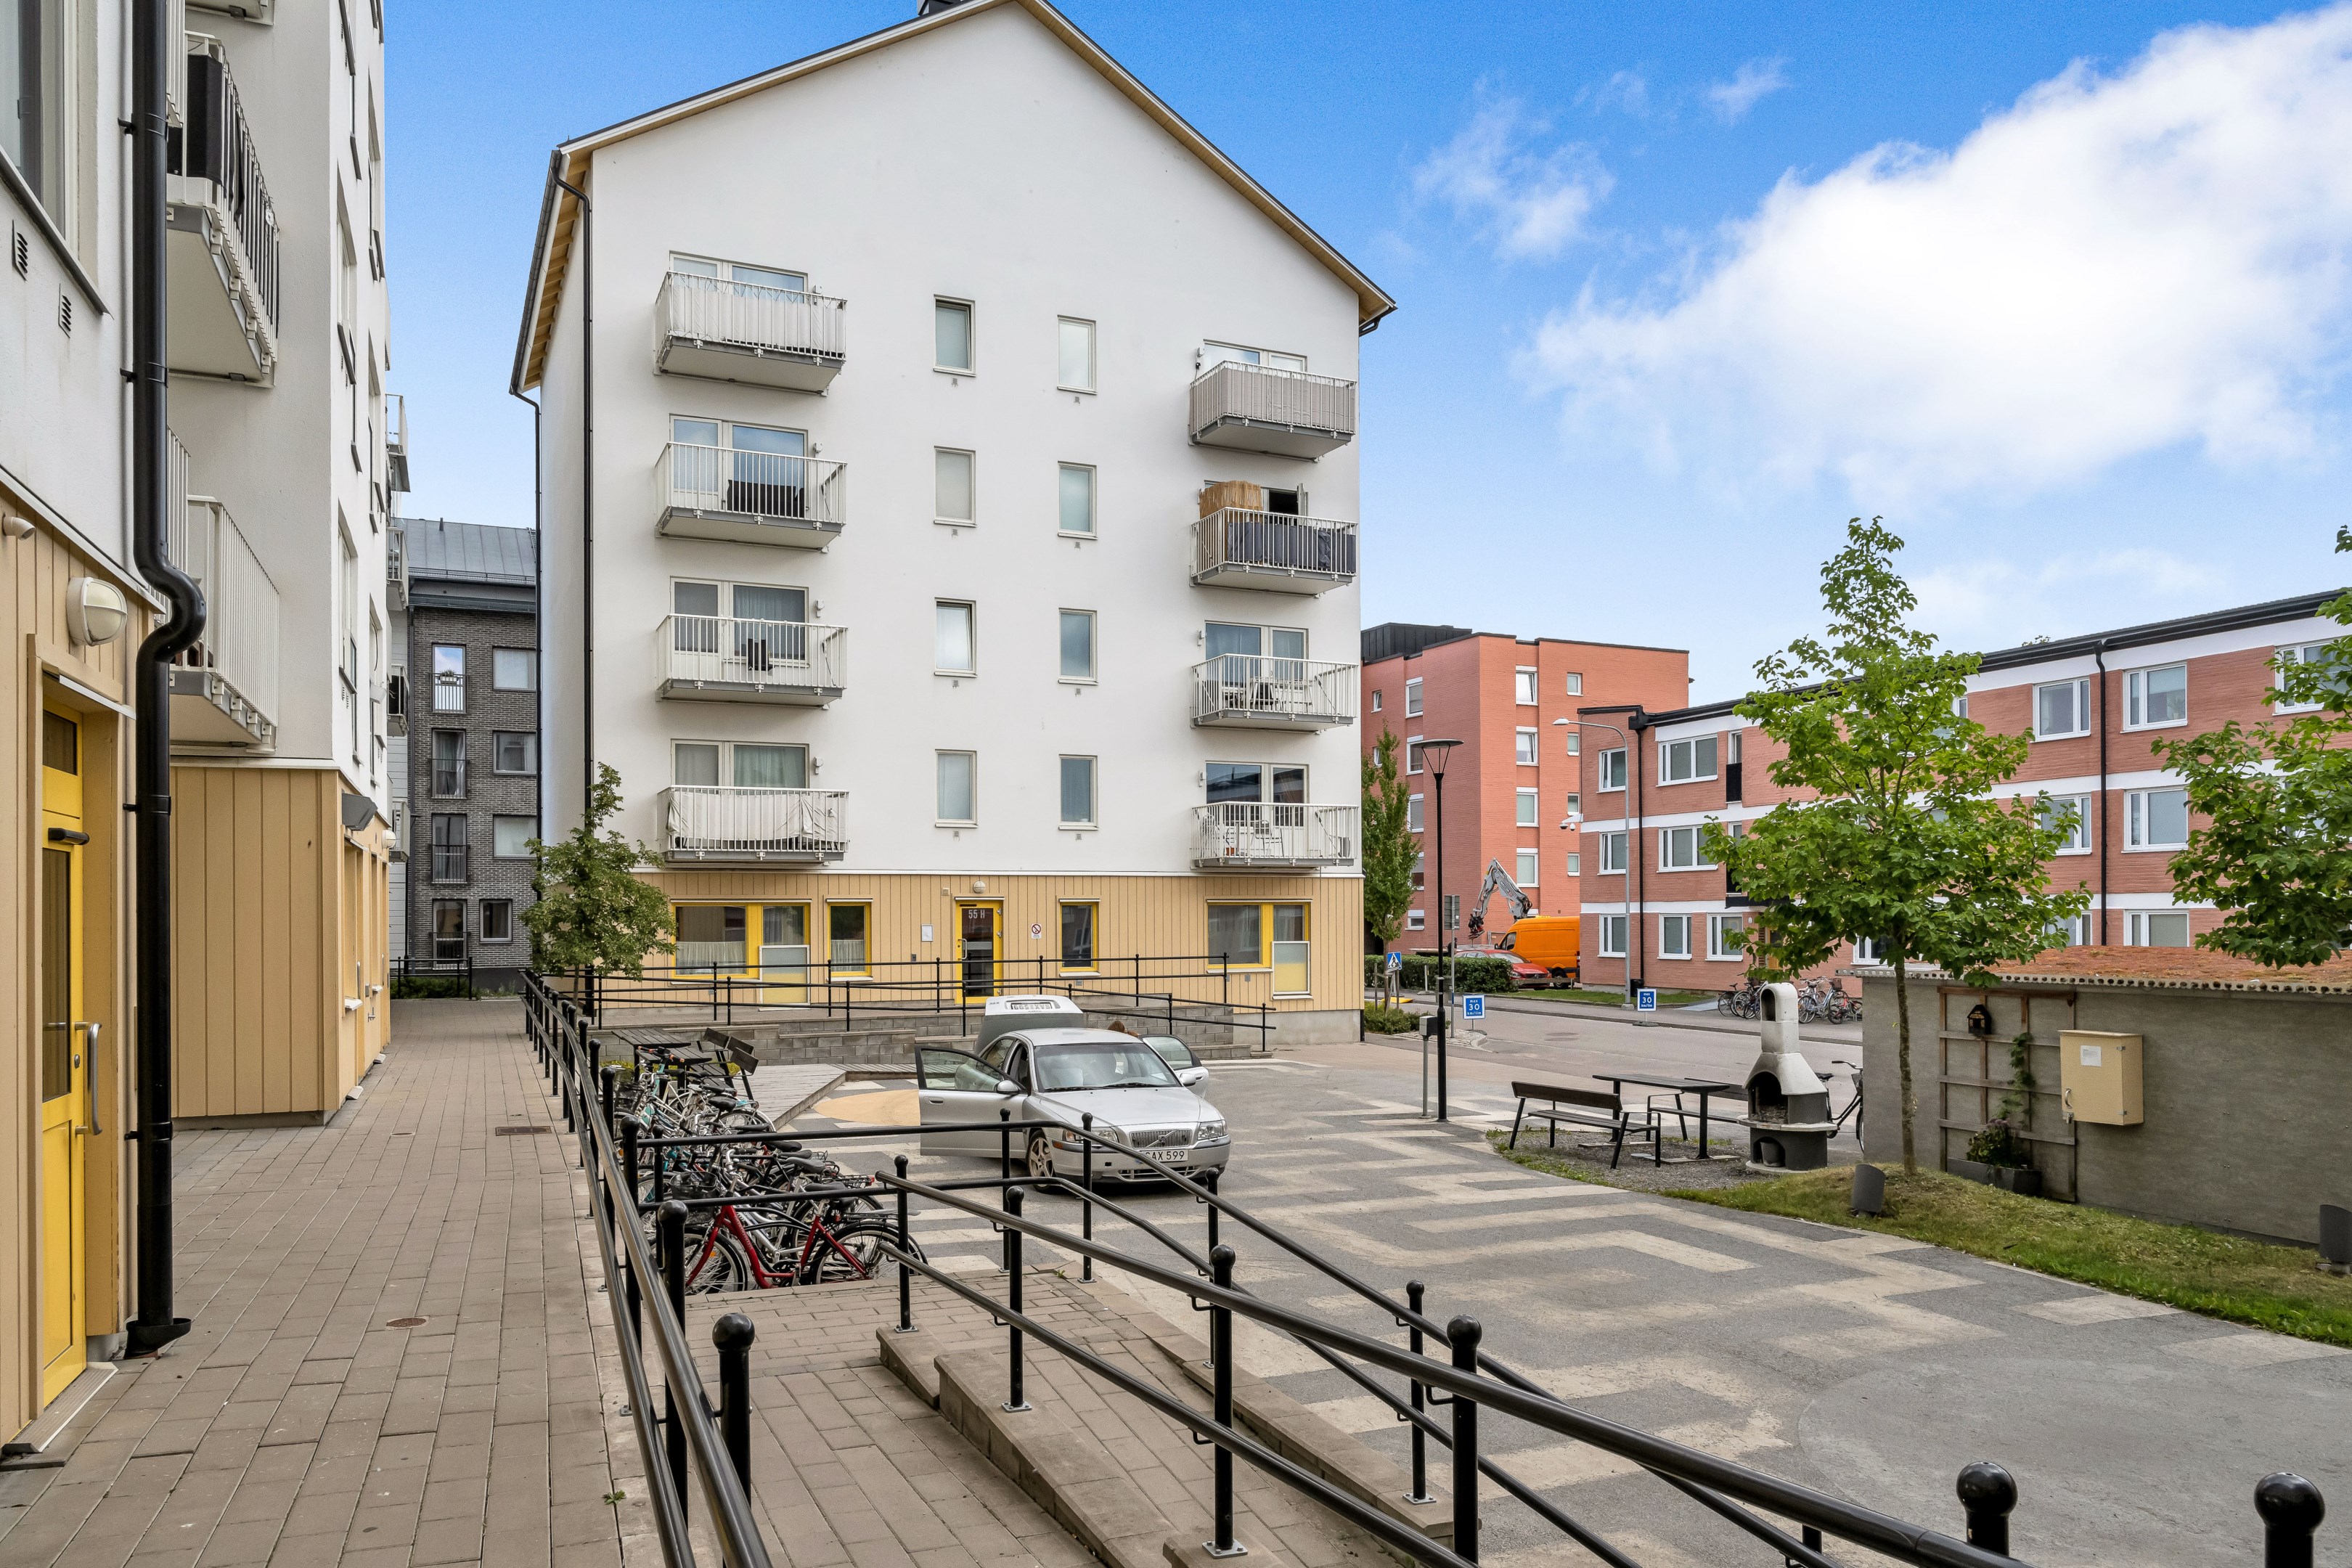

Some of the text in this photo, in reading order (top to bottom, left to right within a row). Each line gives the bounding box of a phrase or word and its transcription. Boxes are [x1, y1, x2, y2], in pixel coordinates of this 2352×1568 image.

[968, 910, 985, 918] 55 H
[1167, 1151, 1185, 1160] 599
